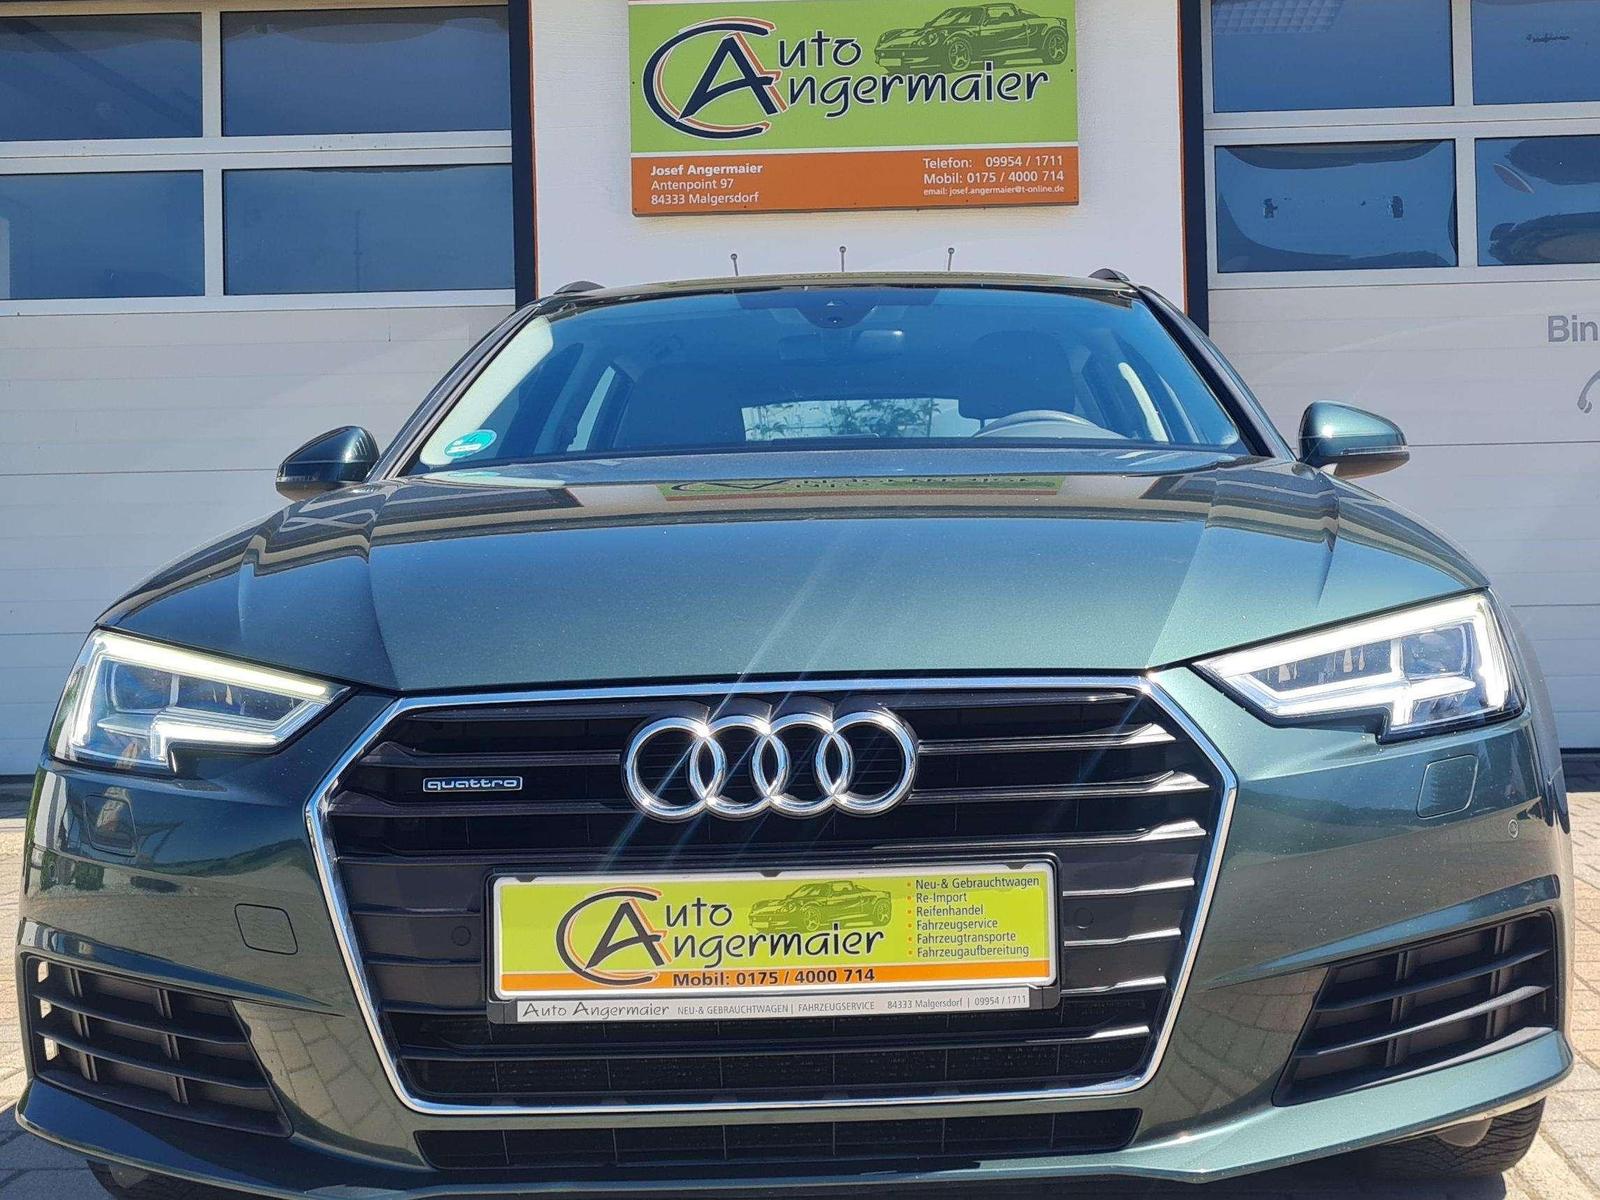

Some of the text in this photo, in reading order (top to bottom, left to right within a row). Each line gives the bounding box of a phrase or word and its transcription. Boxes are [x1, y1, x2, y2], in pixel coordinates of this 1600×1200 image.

[922, 157, 973, 169] Telefon:
[985, 156, 1022, 167] 09954
[1035, 155, 1063, 166] 1711
[650, 163, 763, 177] Josef Angermaier
[923, 172, 963, 184] Mobil:
[966, 172, 996, 183] 0175
[1008, 171, 1038, 182] 4000
[1043, 170, 1065, 181] 714
[651, 178, 734, 191] Antenpoint 97
[923, 185, 1065, 197] email: josef.angermaier@t-online.de
[651, 191, 760, 206] 84333 Malgersdorf
[427, 778, 518, 790] quattro
[952, 877, 1040, 889] Gebrauchtwagen
[916, 892, 968, 905] Re-Import
[916, 904, 984, 917] Reifenhandel
[916, 918, 998, 932] Fahrzeugservice
[917, 932, 1016, 946] Fahrzeugtransporte
[917, 945, 1029, 959] Fahrzeugaufbereitung
[673, 973, 730, 986] Mobil:
[736, 971, 778, 985] 0175
[795, 970, 837, 983] 4000
[843, 968, 875, 982] 714
[522, 1002, 567, 1017] Auto
[572, 1001, 669, 1019] Angermaier
[707, 1004, 788, 1014] GEBRAUCHTWAGEN
[798, 1001, 875, 1012] FAHRZEUGSERVICE
[887, 999, 912, 1009] 84333
[915, 998, 962, 1010] Malgersdorf
[974, 996, 999, 1006] 09954
[1007, 995, 1026, 1005] 1711
